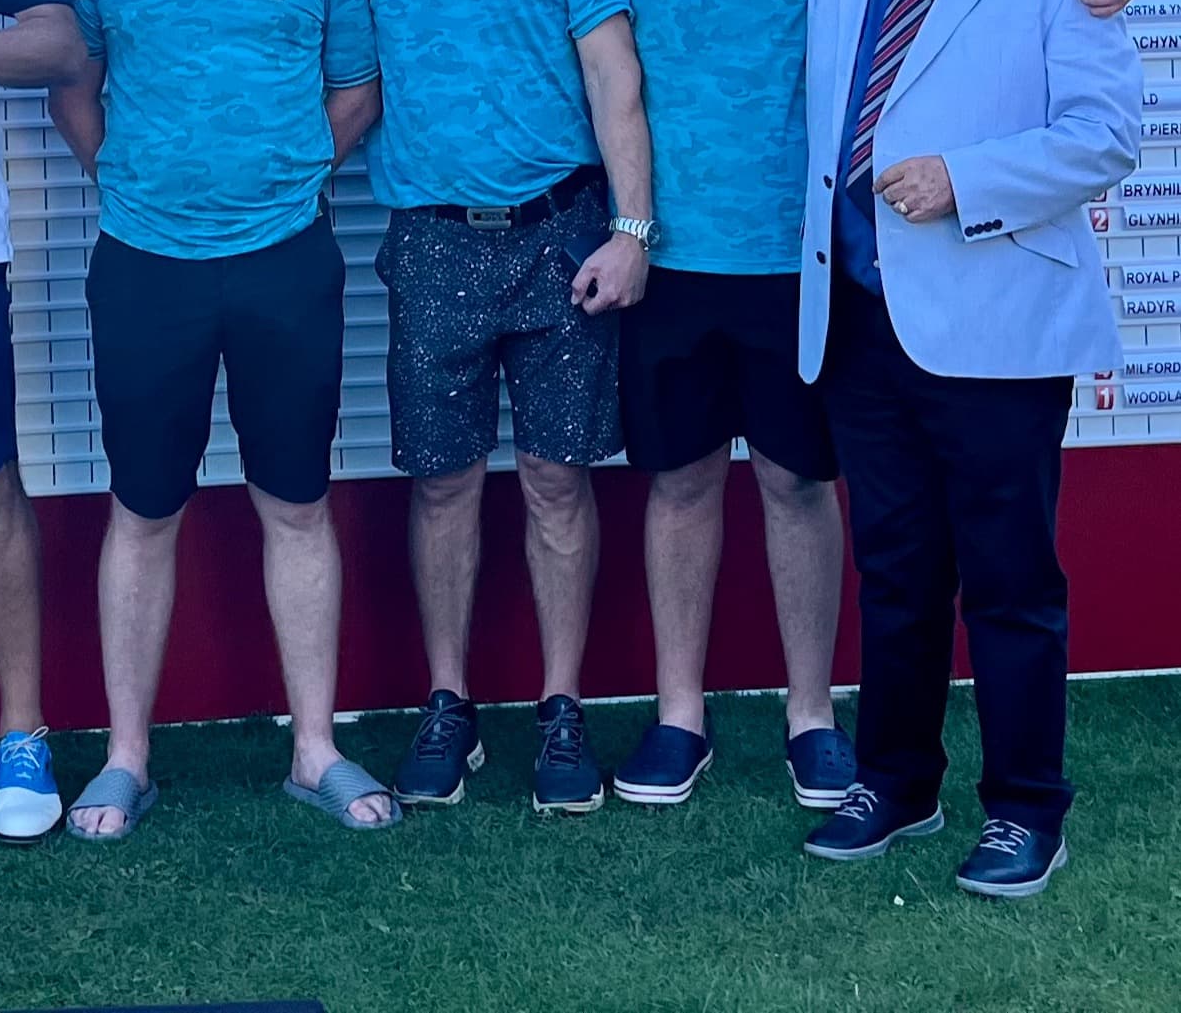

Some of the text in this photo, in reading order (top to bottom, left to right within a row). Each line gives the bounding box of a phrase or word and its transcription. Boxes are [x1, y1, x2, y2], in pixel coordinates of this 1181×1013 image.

[1125, 5, 1156, 16] ORTH
[1159, 4, 1167, 15] &
[1133, 35, 1181, 49] CHYN
[1150, 122, 1181, 136] PIER
[1094, 209, 1107, 231] 2
[1128, 212, 1181, 227] GLYNHI
[1126, 270, 1169, 285] ROYAL
[1127, 299, 1176, 315] RADYR
[1125, 362, 1181, 376] MILFORD
[1099, 387, 1110, 408] 1
